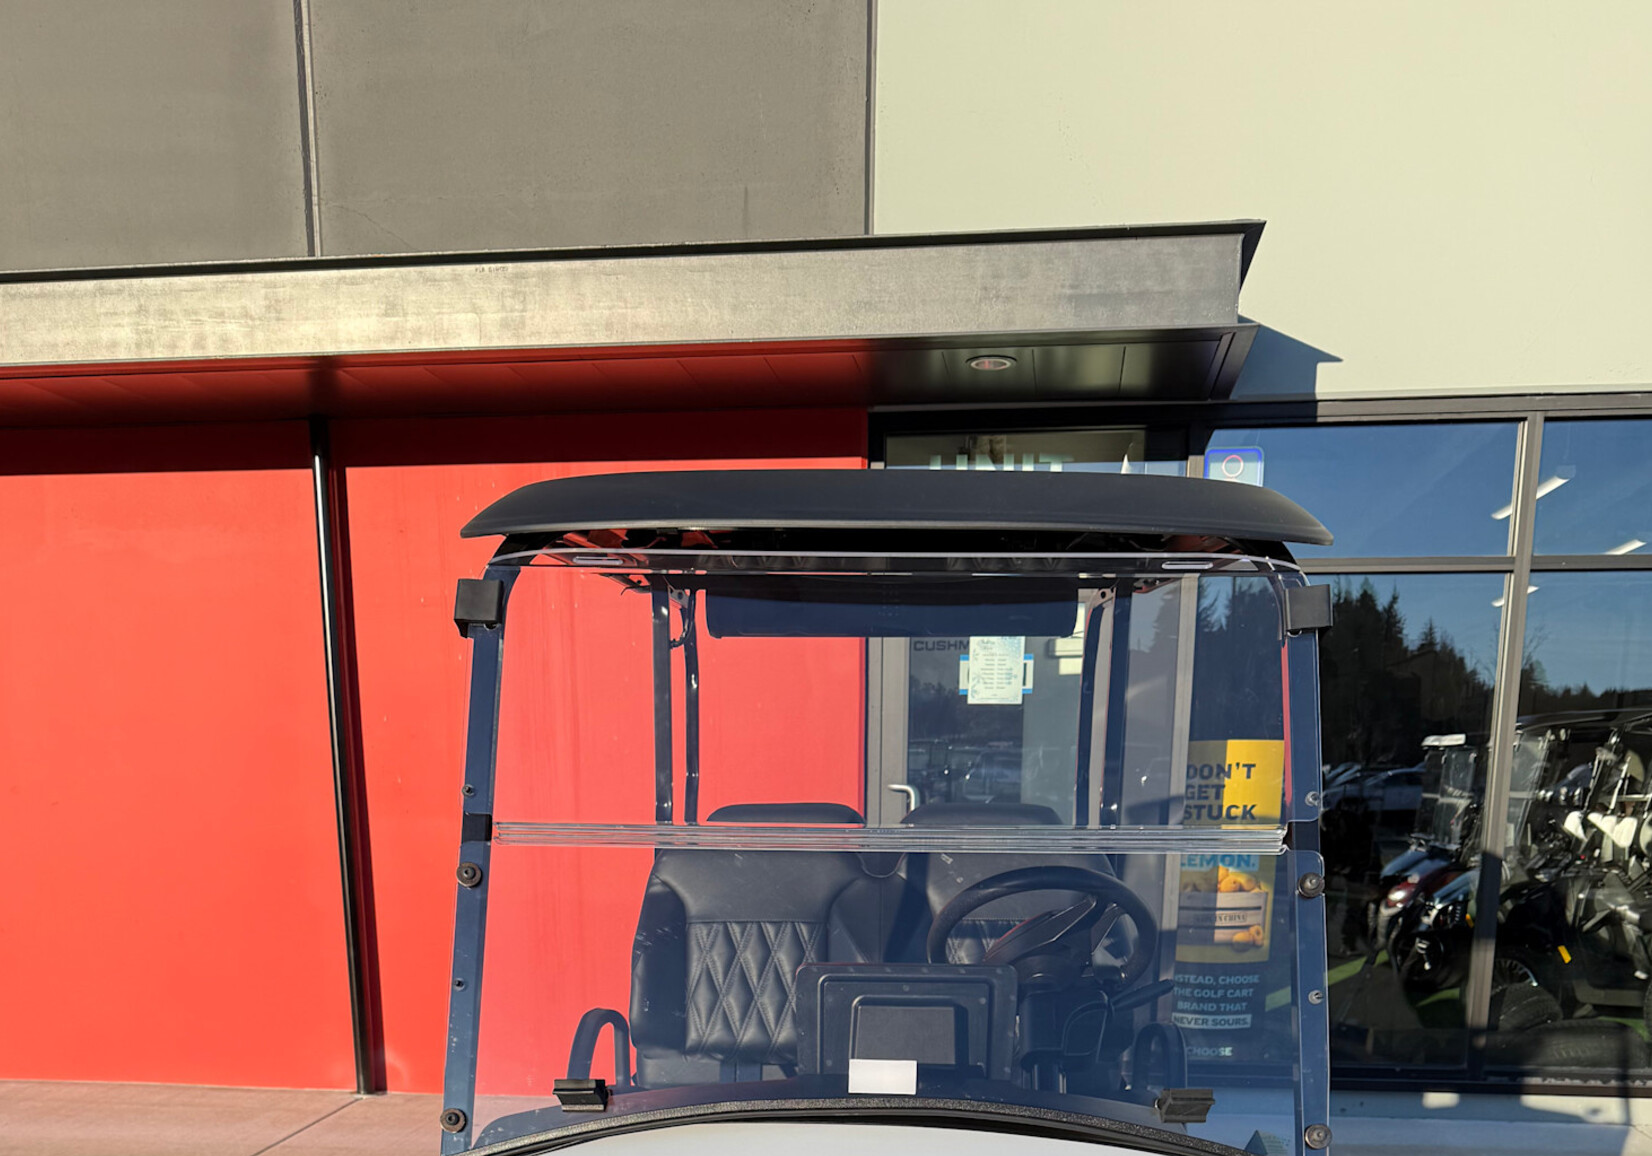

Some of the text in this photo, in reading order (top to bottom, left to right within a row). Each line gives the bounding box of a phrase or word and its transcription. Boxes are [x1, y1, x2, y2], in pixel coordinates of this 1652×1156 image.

[1187, 763, 1257, 780] DON'T
[1185, 784, 1225, 800] GET
[1183, 804, 1257, 821] STUCK
[1218, 975, 1260, 985] CHOOSE
[1174, 987, 1254, 998] THE GOLF CART
[1177, 1001, 1248, 1012] BRAND THAT
[1173, 1015, 1209, 1026] NEVER
